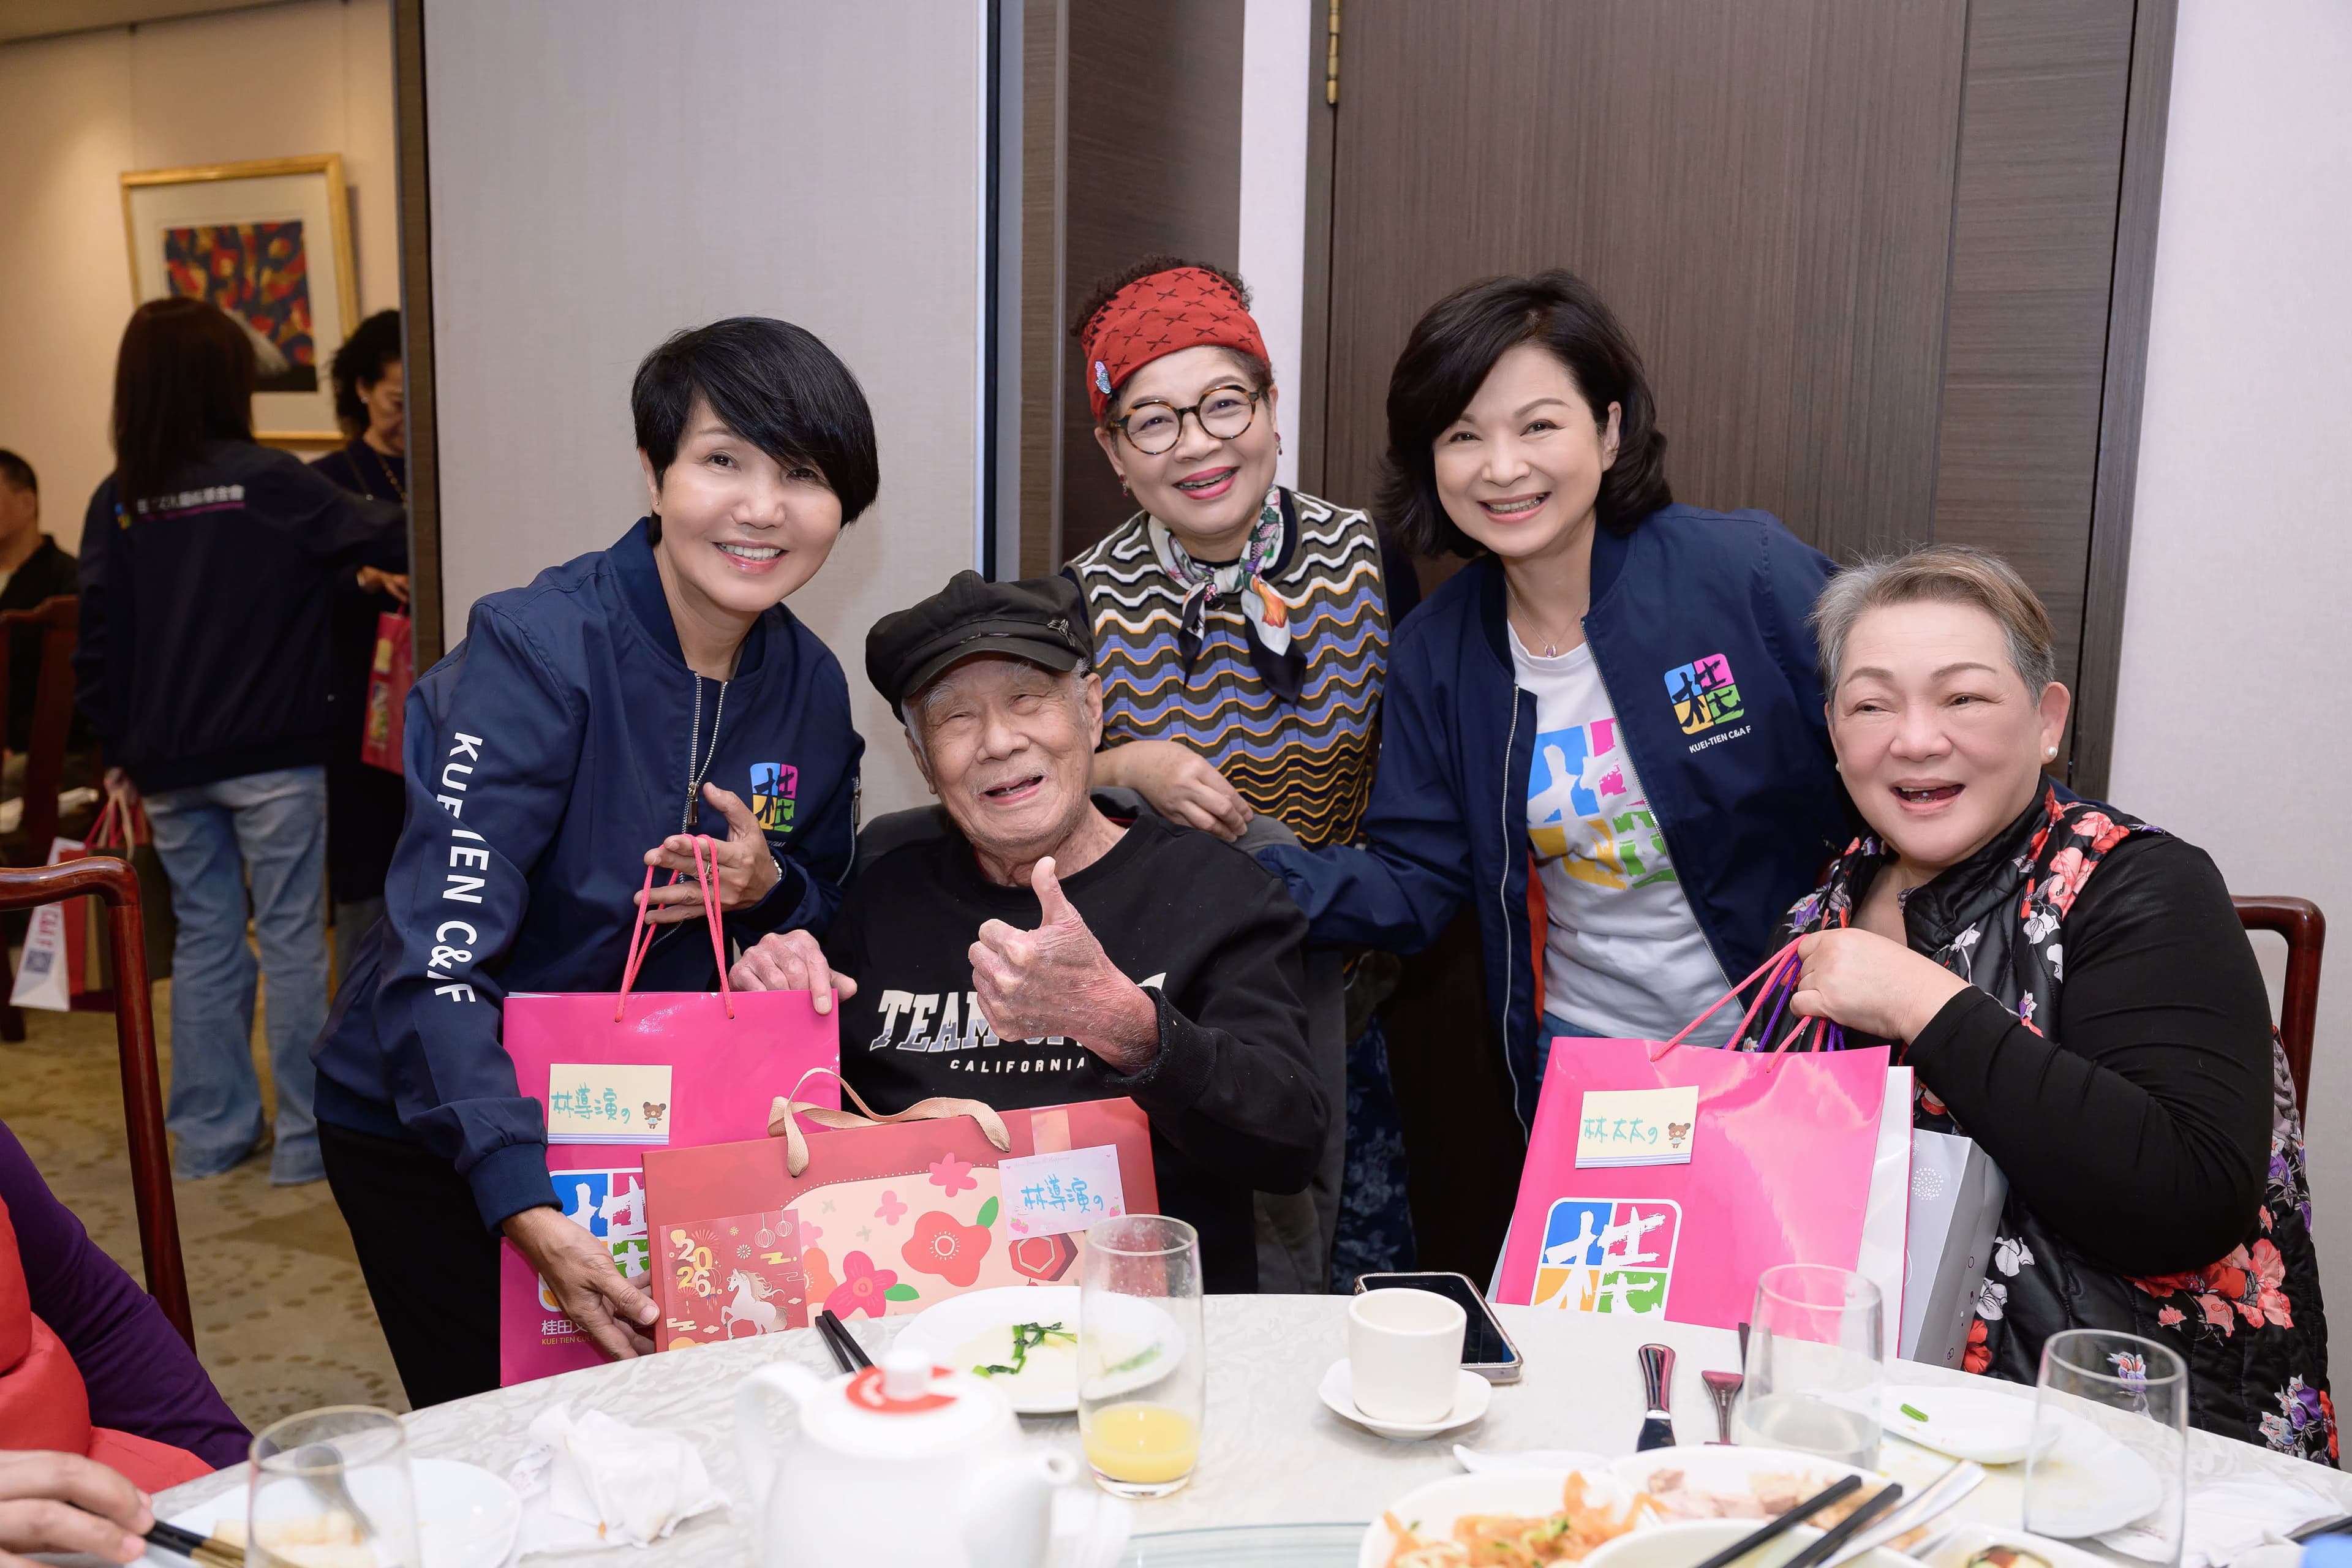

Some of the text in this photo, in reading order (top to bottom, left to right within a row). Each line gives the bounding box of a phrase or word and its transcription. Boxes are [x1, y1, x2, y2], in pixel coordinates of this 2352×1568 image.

[1689, 725, 1752, 754] KUEI-TIEN C&A F
[869, 990, 1000, 1053] TEAM
[949, 1056, 1085, 1073] CALIFORNIA
